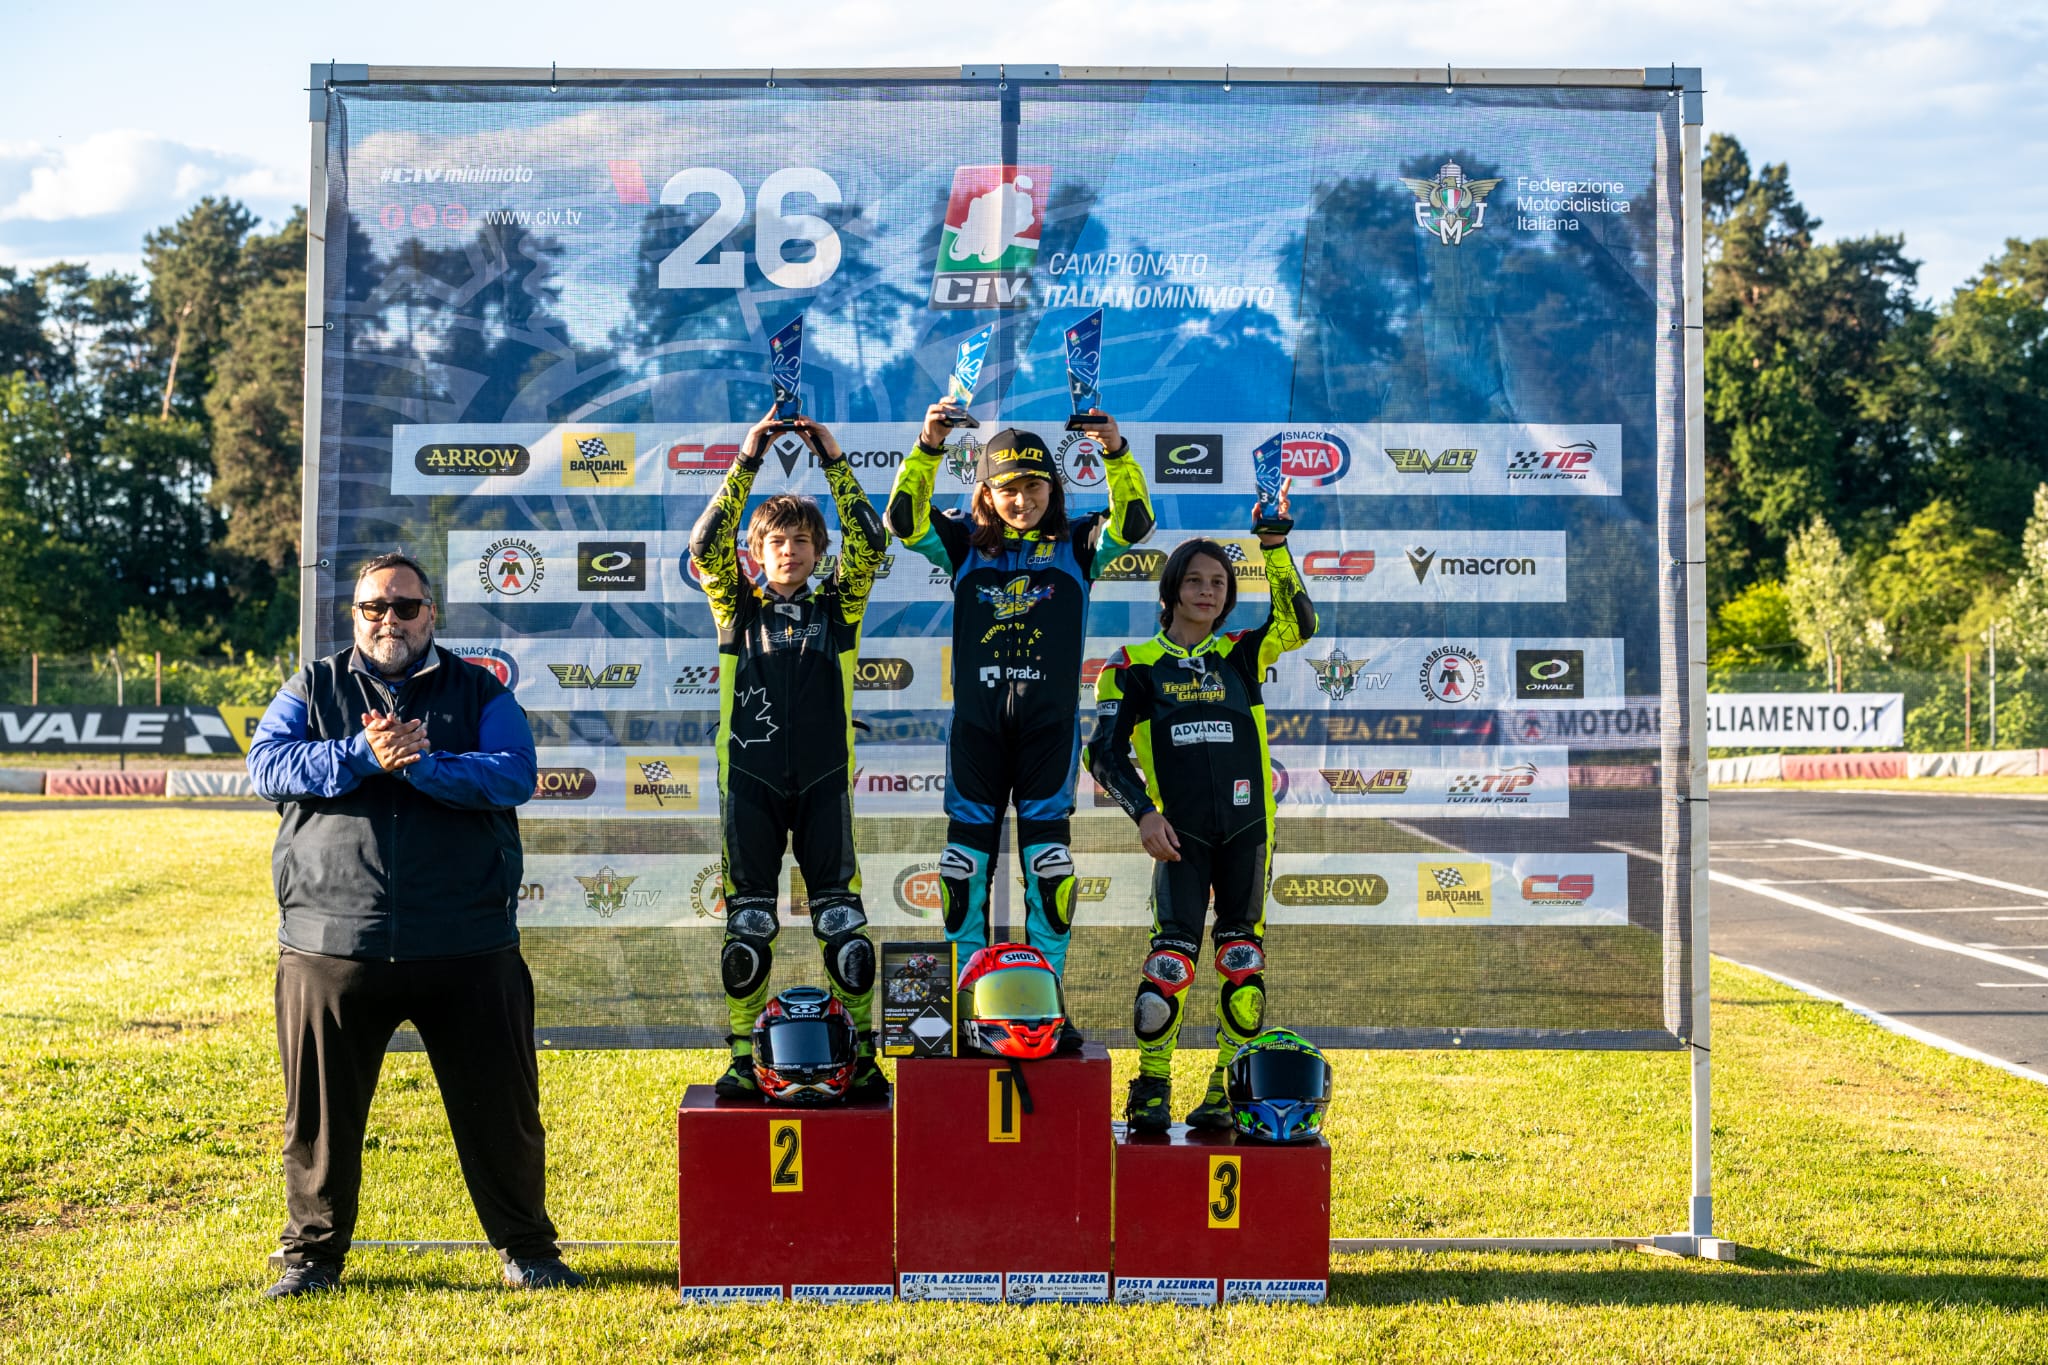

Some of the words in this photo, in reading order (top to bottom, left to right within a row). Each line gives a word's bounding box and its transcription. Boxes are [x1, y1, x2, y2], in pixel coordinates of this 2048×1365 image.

[1517, 177, 1624, 194] Federazione
[1517, 196, 1630, 214] Motociclistica
[486, 208, 582, 225] www.civ.tv
[1517, 216, 1579, 231] Italiana
[1049, 252, 1208, 276] CAMPIONATO
[1043, 285, 1274, 309] ITALIANOMINIMOTO
[777, 390, 785, 401] 2
[1073, 382, 1081, 394] 1
[425, 449, 519, 467] ARROW
[667, 444, 740, 470] CS
[808, 451, 904, 468] mcron
[1282, 449, 1331, 469] PATA
[1540, 452, 1593, 468] TIP
[570, 460, 627, 472] BARDAHL
[1261, 492, 1269, 502] 3
[479, 537, 545, 594] MOTOABBIGLIAMENTO.IT
[1303, 551, 1375, 575] CS
[1441, 557, 1536, 576] macron
[1365, 673, 1392, 689] TV
[1416, 646, 1487, 702] MOTOABBIGLIAMENTO.IT
[1173, 724, 1232, 737] ADVANCE
[634, 784, 691, 795] BARDAHL
[1482, 775, 1536, 792] TIP
[1284, 879, 1377, 896] ARROW
[1521, 875, 1594, 899] CS
[633, 890, 661, 907] TV
[1427, 890, 1483, 902] BARDAHL
[1005, 952, 1036, 962] SHOEI
[997, 1071, 1013, 1133] 1
[773, 1126, 799, 1186] 2
[1210, 1161, 1239, 1222] 3
[941, 1274, 1000, 1284] AZZURRA
[1008, 1274, 1043, 1284] PISTA
[1048, 1274, 1106, 1284] AZZURRA
[1117, 1279, 1152, 1289] PISTA
[1157, 1279, 1215, 1290] AZZURRA
[1226, 1281, 1262, 1291] PISTA
[1266, 1281, 1324, 1291] AZZURRA
[683, 1287, 718, 1298] PISTA
[722, 1286, 781, 1297] AZZURRA
[794, 1286, 830, 1296] PISTA
[833, 1286, 891, 1296] AZZURRA
